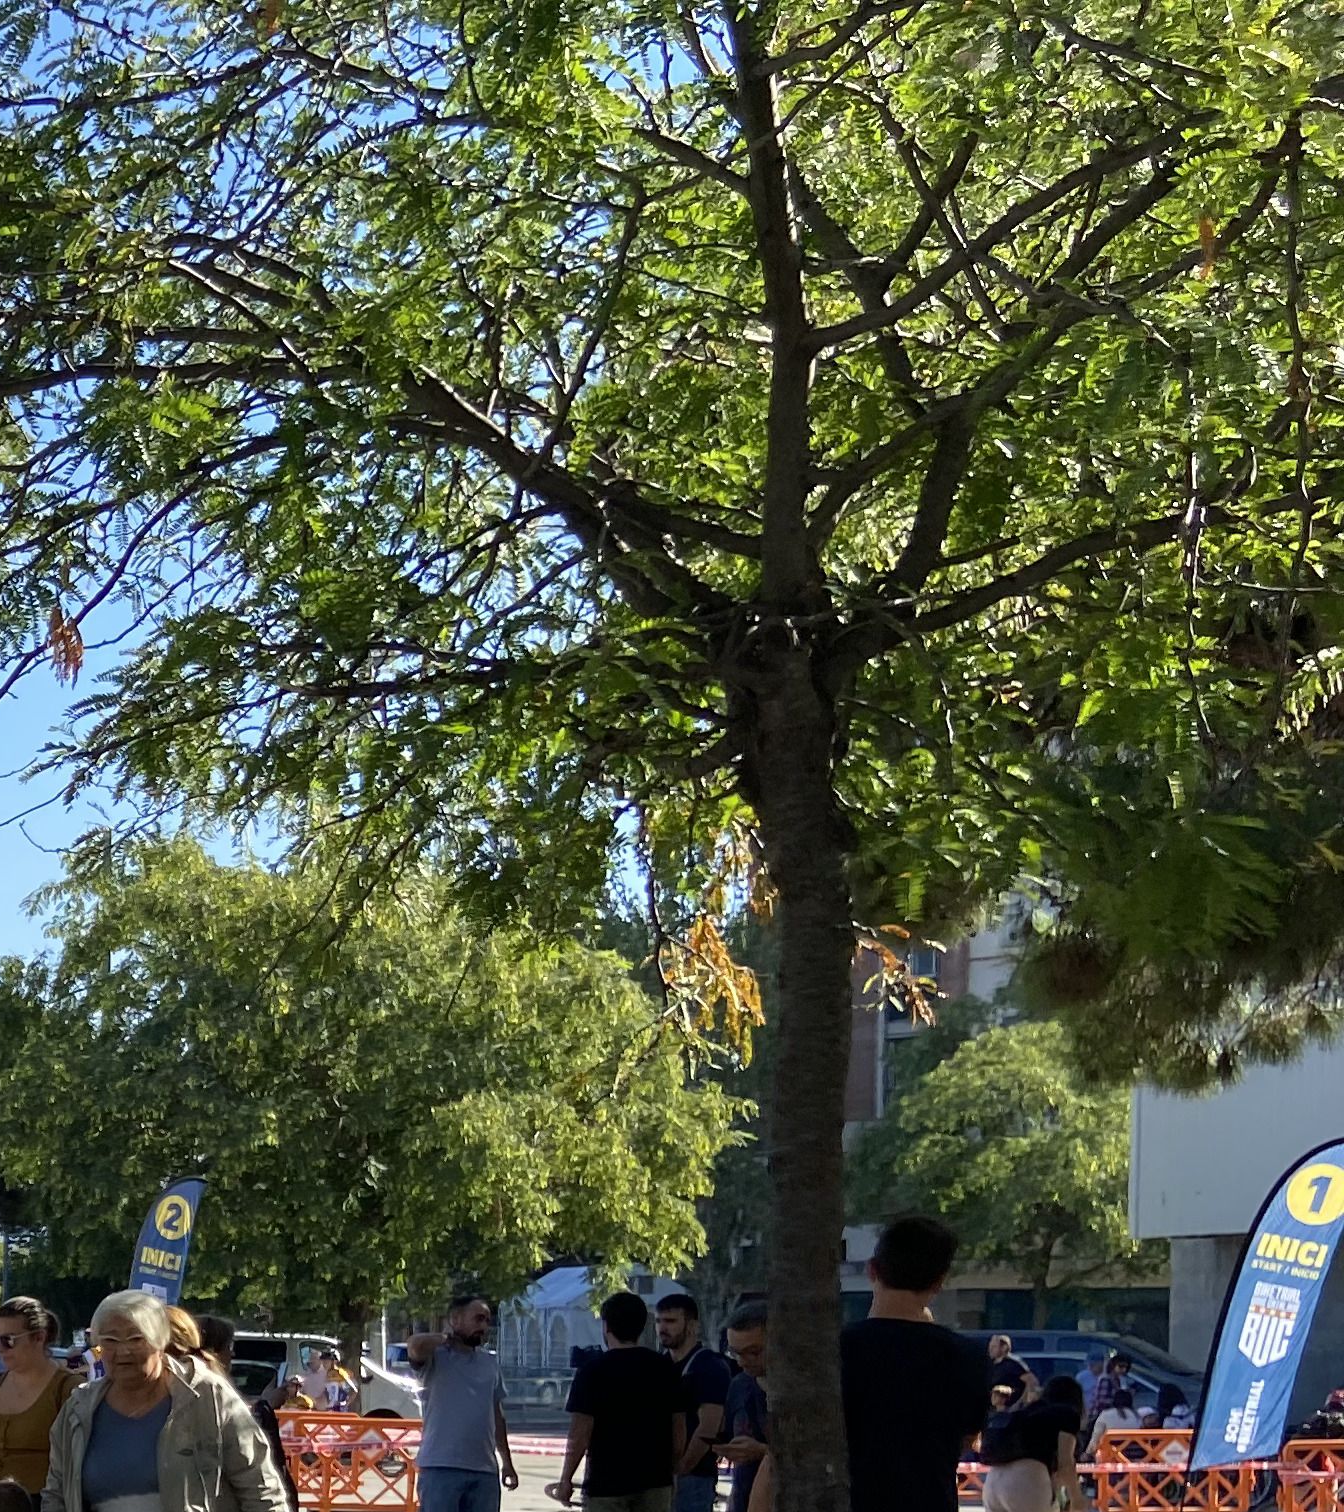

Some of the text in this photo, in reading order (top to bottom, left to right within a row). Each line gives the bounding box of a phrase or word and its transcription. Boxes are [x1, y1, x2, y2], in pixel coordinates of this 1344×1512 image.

[1307, 1175, 1333, 1215] 1
[163, 1203, 182, 1232] 2
[140, 1246, 182, 1273] INICI
[1256, 1232, 1329, 1269] INICI
[1251, 1259, 1283, 1275] START
[1290, 1267, 1320, 1281] INICIO
[1238, 1312, 1296, 1368] BUC
